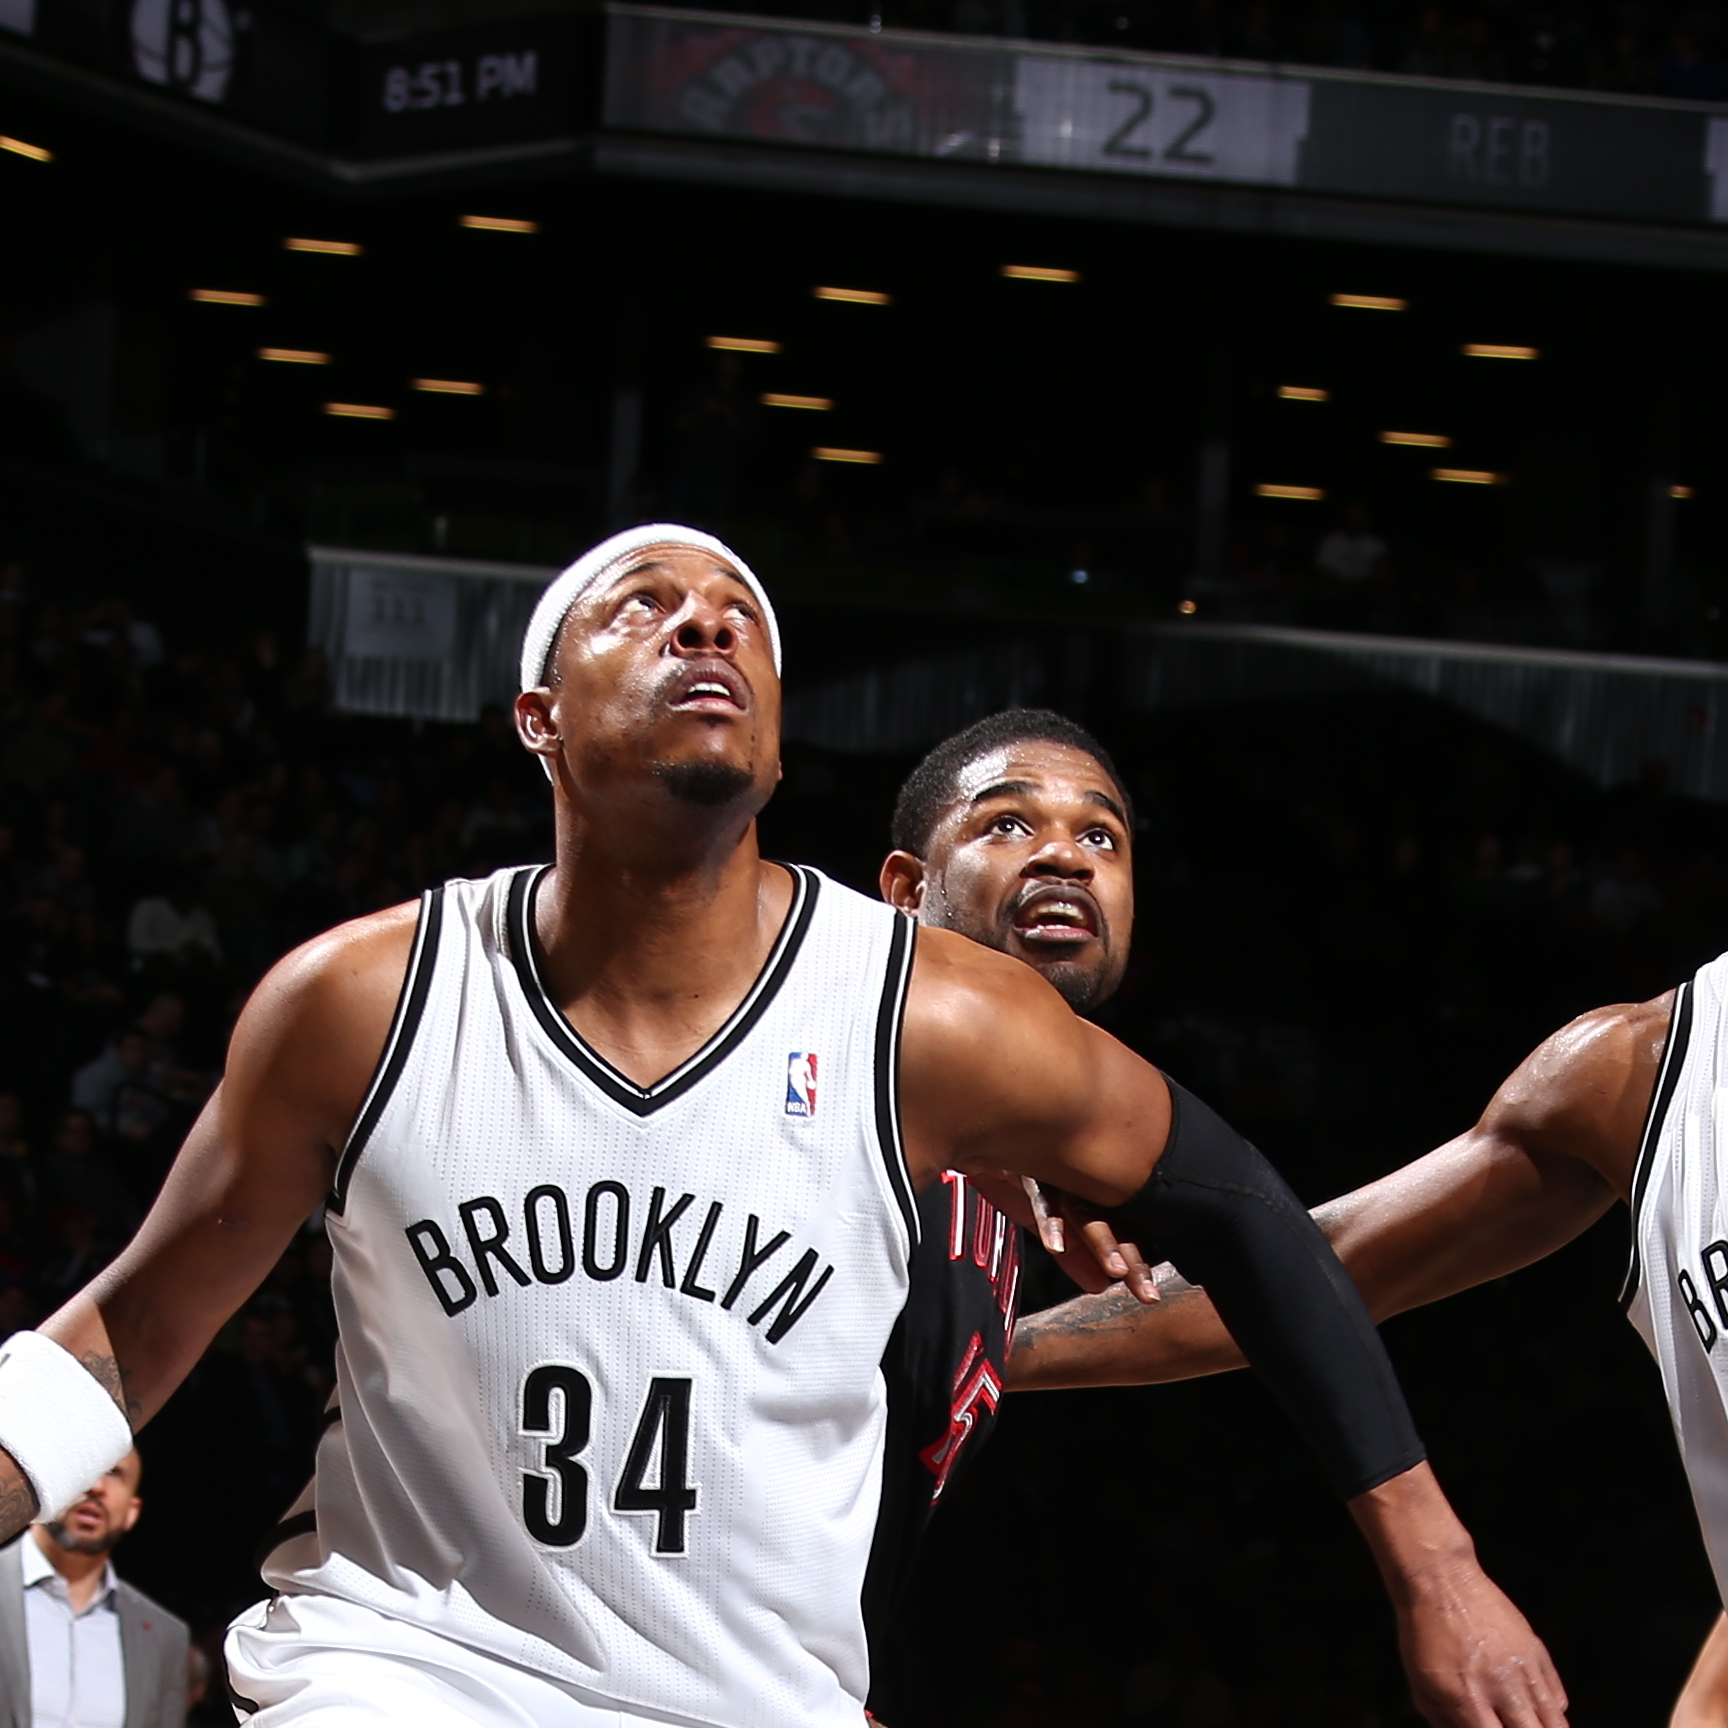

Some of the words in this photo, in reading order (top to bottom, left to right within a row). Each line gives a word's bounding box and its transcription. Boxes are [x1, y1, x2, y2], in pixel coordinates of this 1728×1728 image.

[383, 60, 465, 113] 8:51
[477, 50, 538, 99] PM
[1103, 80, 1216, 164] 22
[1449, 114, 1551, 188] REB
[404, 1180, 835, 1346] BROOKLYN
[517, 1358, 702, 1559] 34
